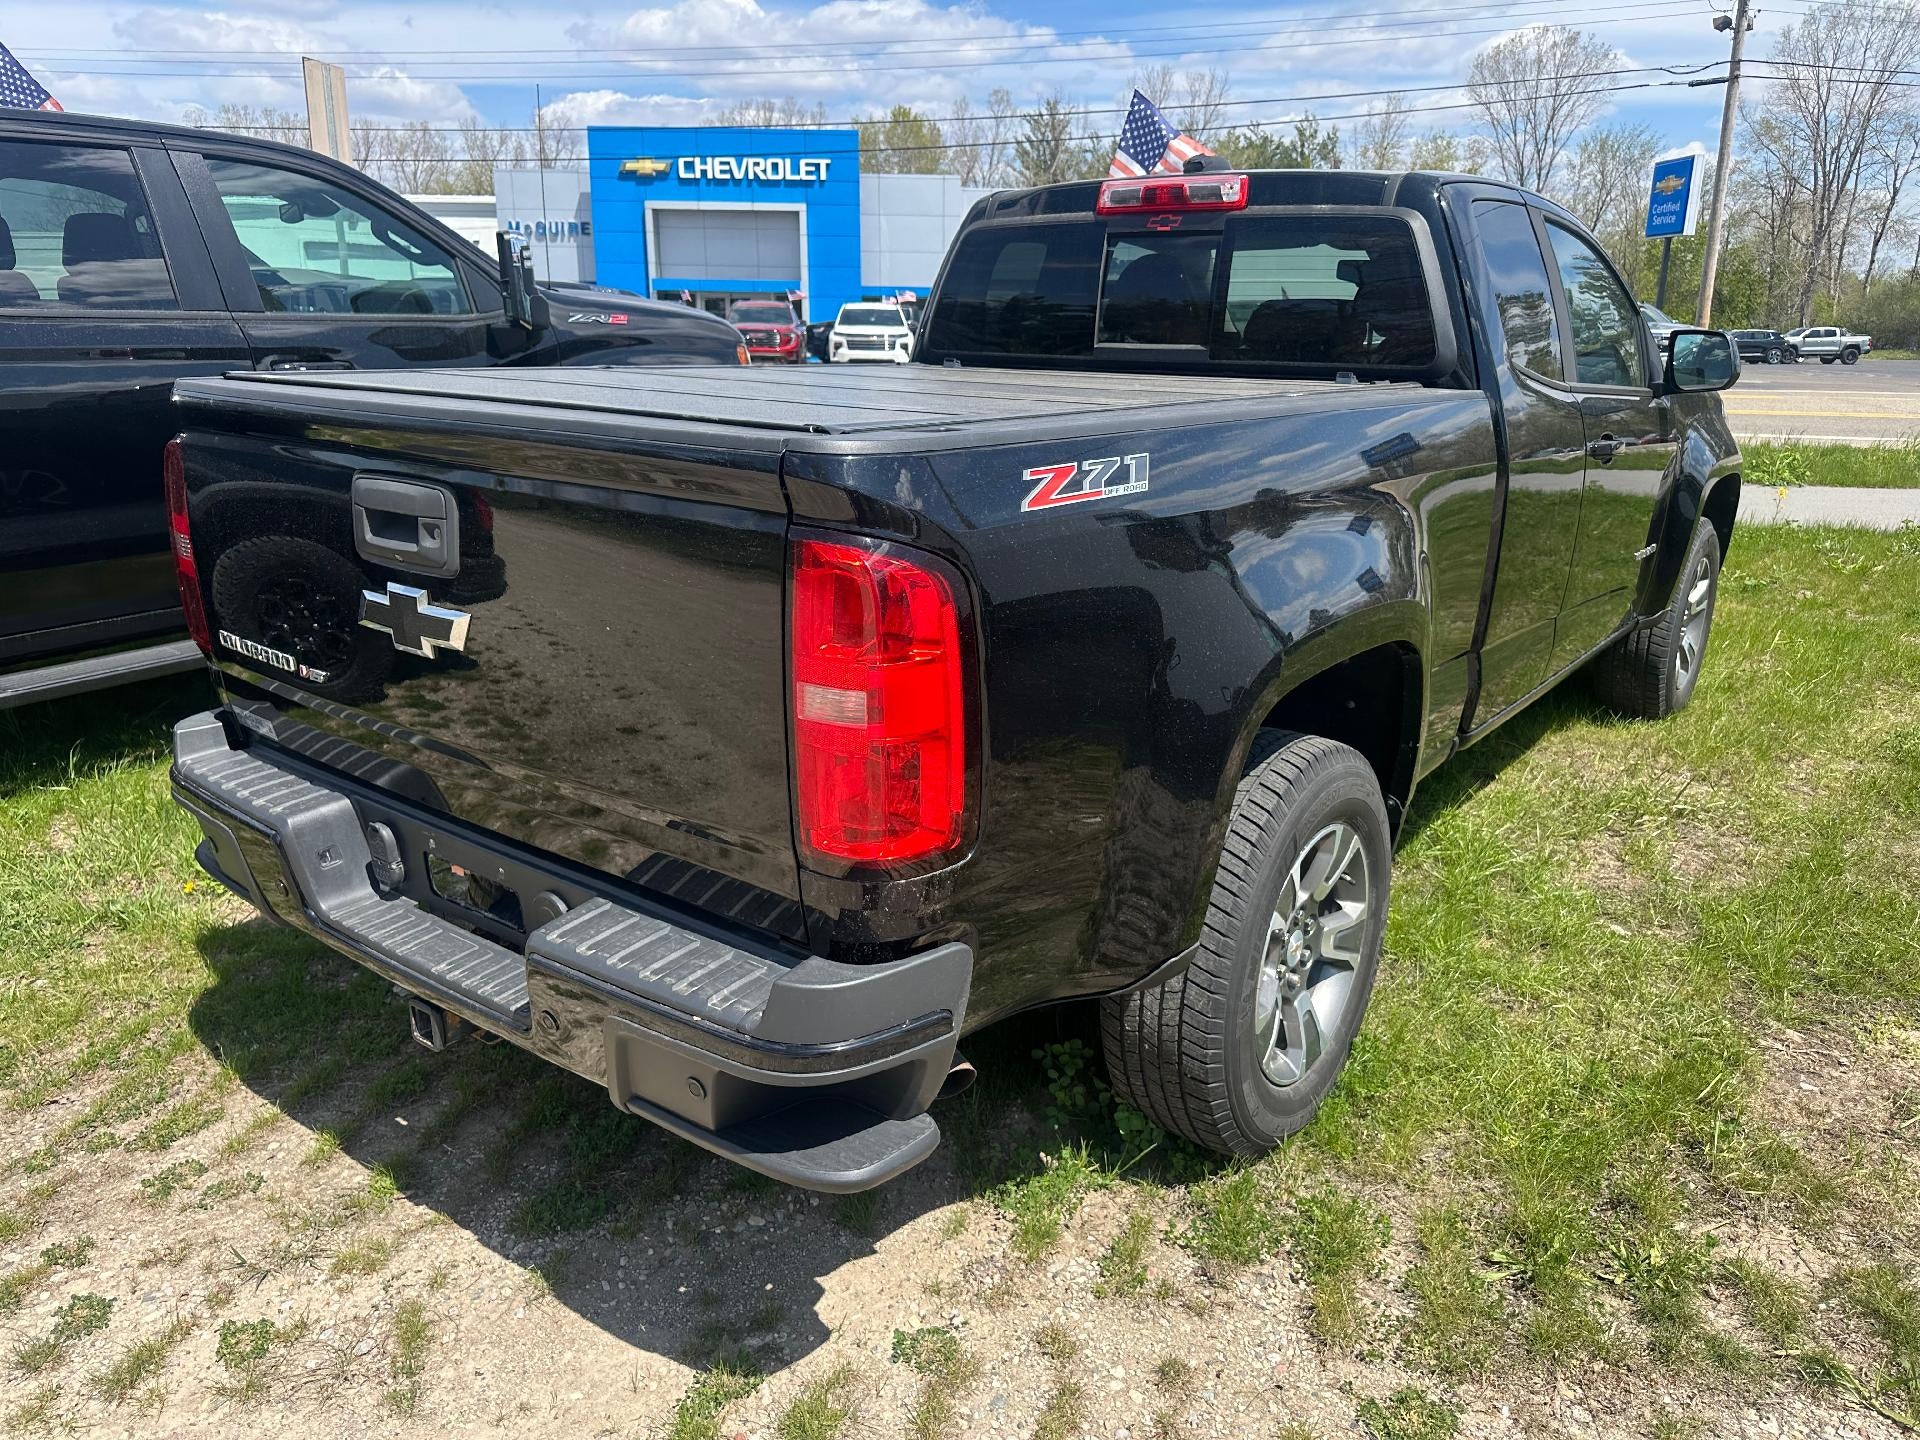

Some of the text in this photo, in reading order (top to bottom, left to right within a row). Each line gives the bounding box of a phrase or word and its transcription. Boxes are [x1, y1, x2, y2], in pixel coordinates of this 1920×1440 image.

[678, 157, 831, 181] CHEVROLET
[1651, 200, 1680, 214] Certified
[1652, 214, 1677, 225] Service
[1020, 452, 1149, 512] Z71
[1103, 481, 1148, 496] OFF ROAD
